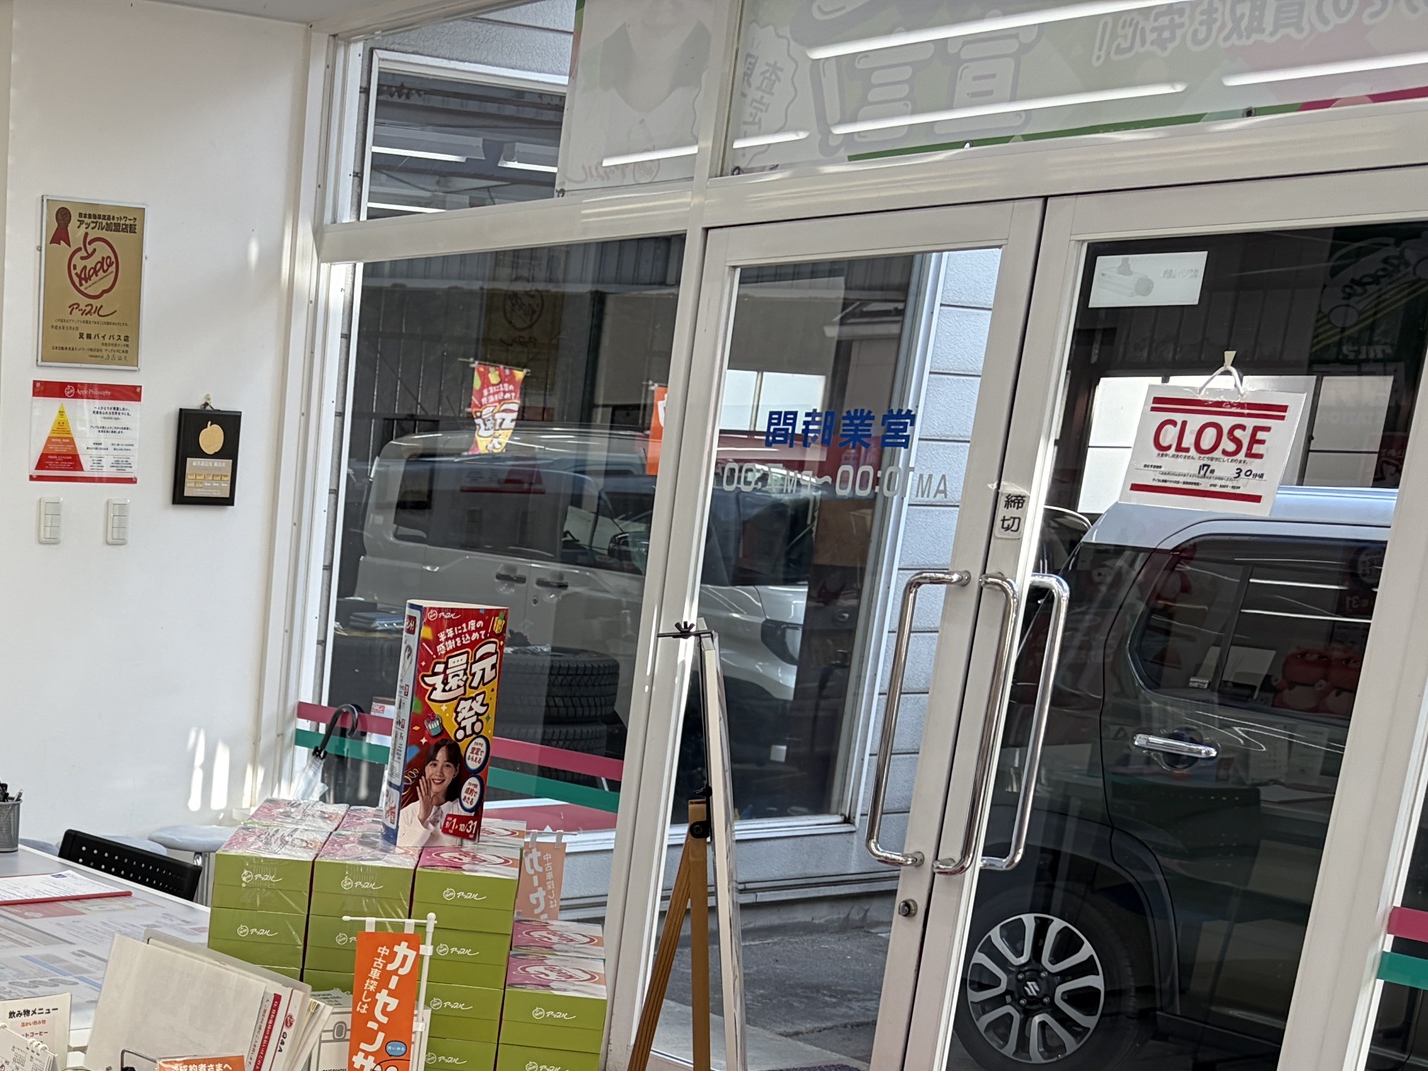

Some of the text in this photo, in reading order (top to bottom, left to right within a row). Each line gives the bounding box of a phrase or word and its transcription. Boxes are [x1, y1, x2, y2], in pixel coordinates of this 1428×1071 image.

[77, 220, 137, 234] アップル加盟店証
[1153, 419, 1272, 459] CLOSE
[1198, 464, 1211, 477] 17
[1233, 468, 1252, 478] 30
[1000, 493, 1026, 533] 締切
[437, 620, 484, 642] 半年に1度の
[356, 945, 389, 1014] 中古車探しは
[8, 1006, 58, 1019] 飲み物メニュー
